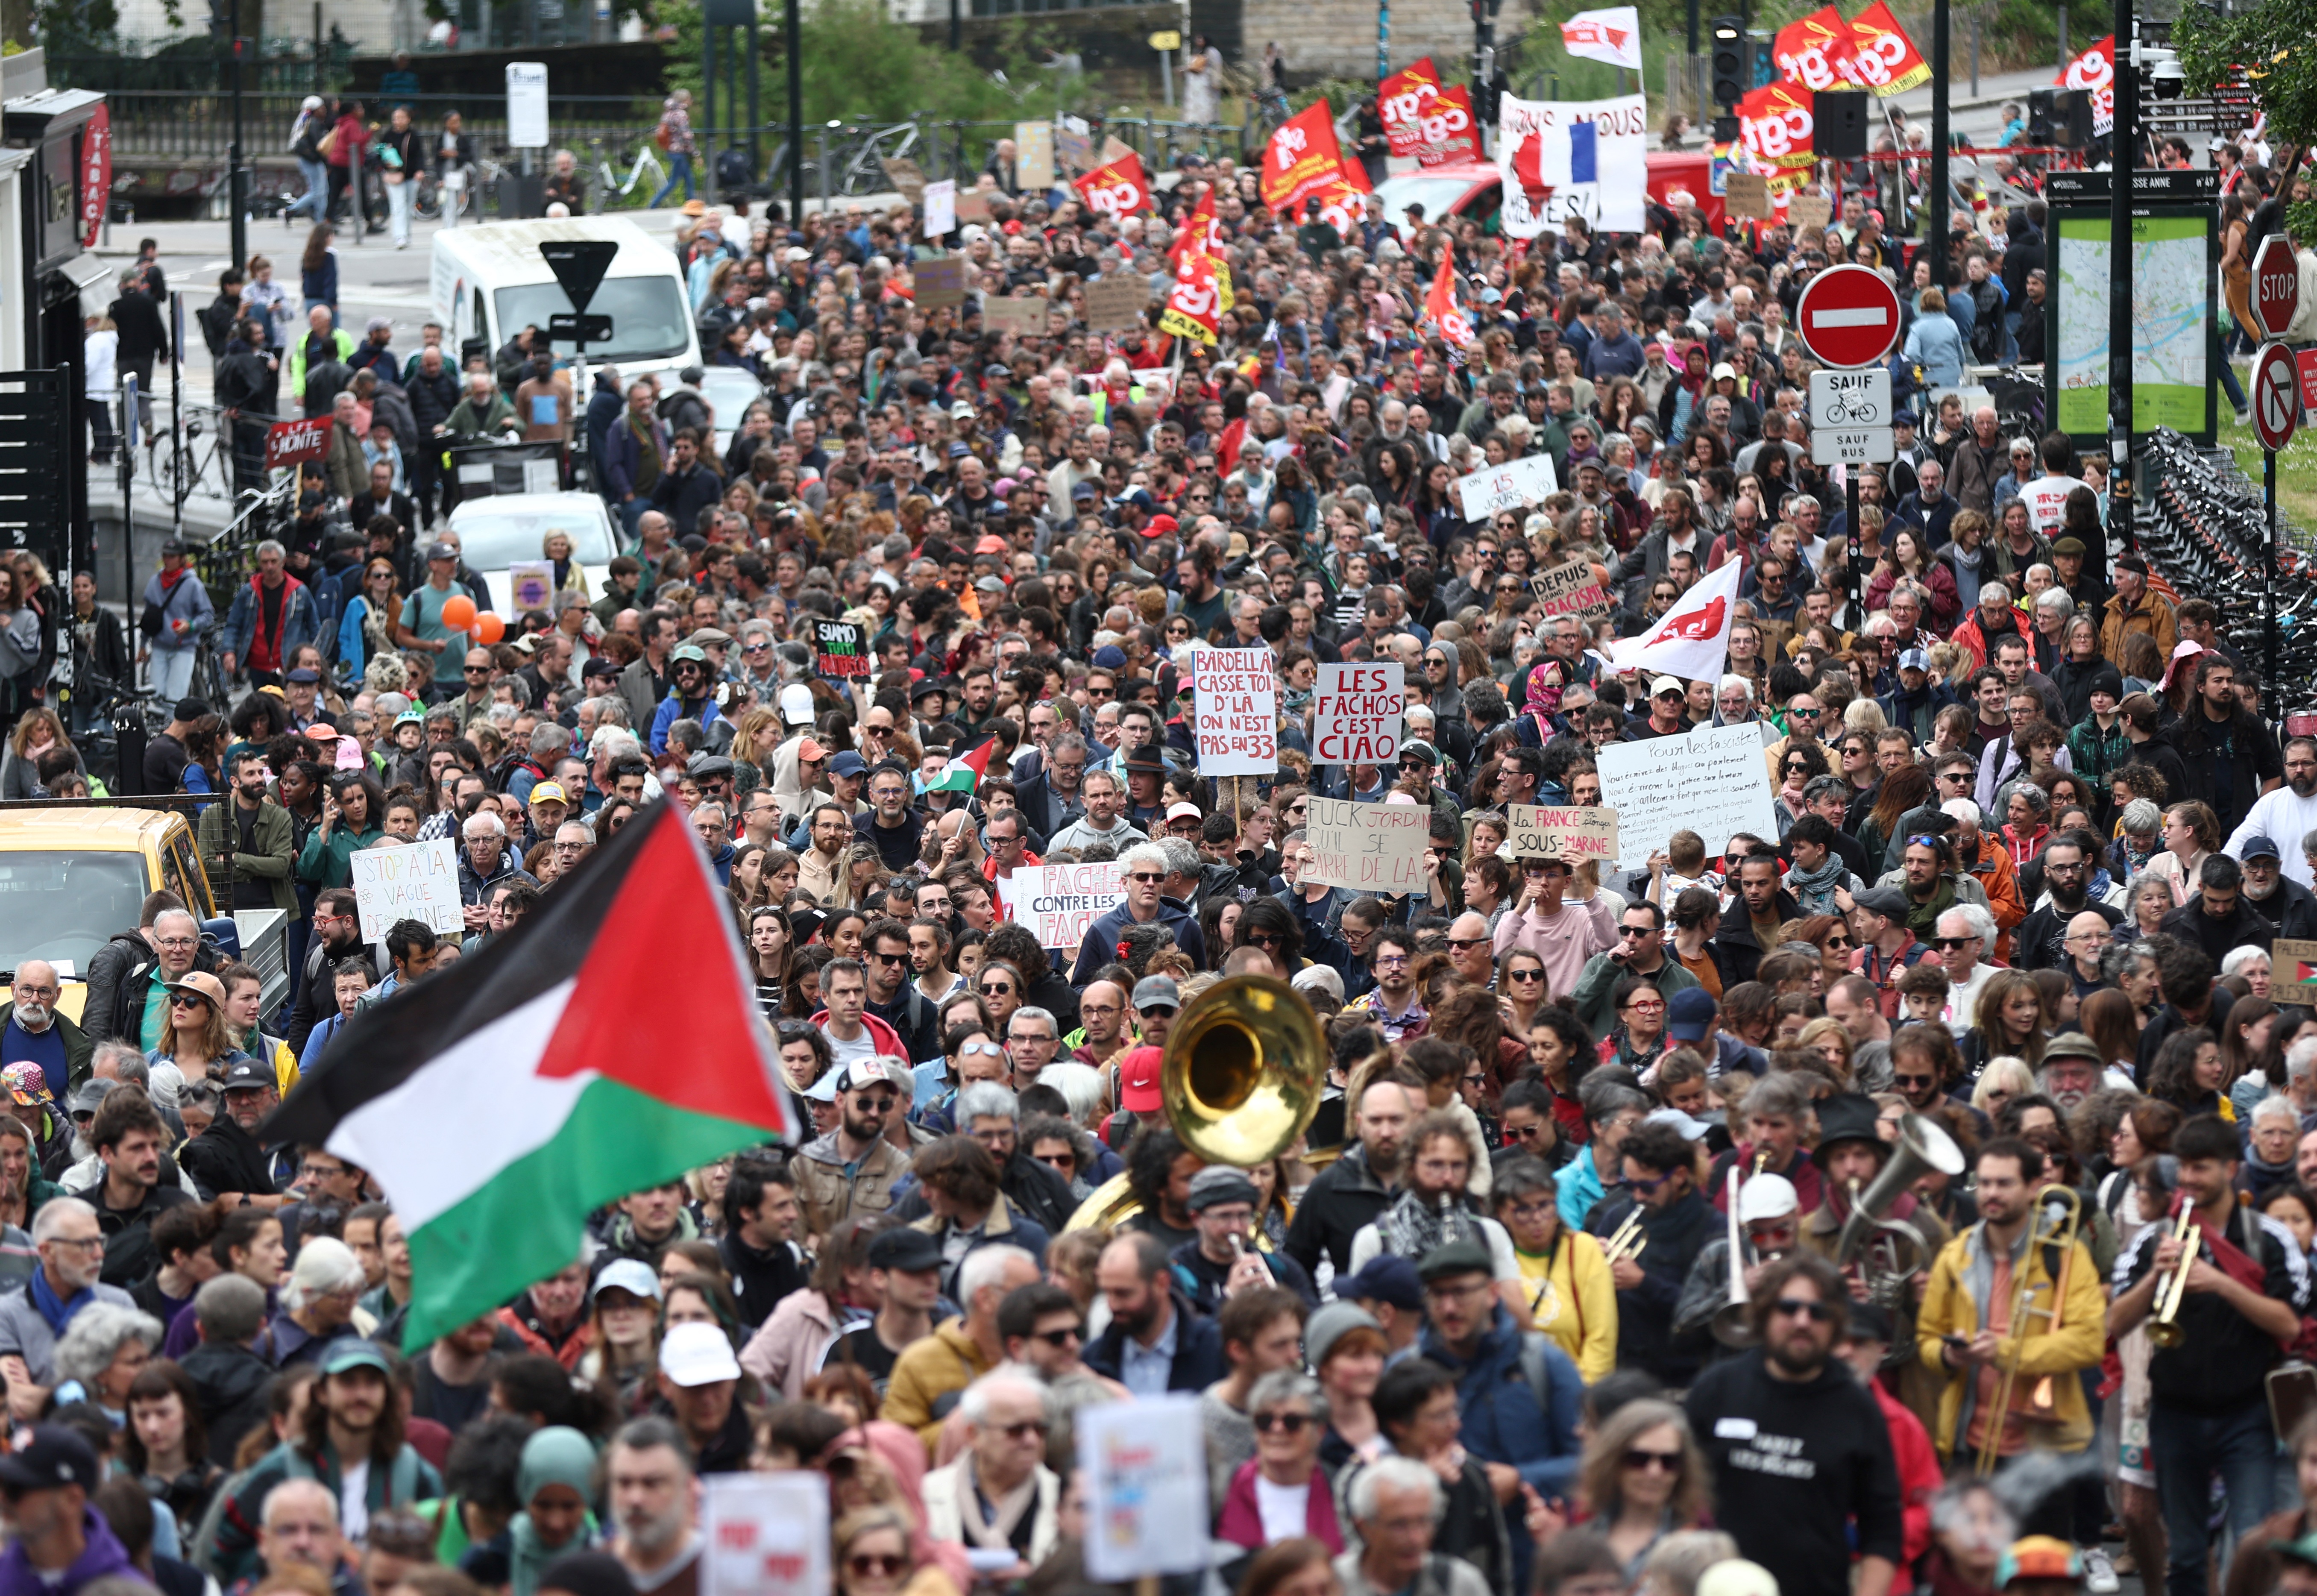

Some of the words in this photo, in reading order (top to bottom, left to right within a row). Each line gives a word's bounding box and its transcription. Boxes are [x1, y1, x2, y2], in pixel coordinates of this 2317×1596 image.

[2197, 106, 2216, 114] Jardin
[2229, 104, 2252, 113] Plantes
[2200, 123, 2215, 132] gare
[86, 132, 104, 219] TABAC
[2149, 177, 2170, 188] ANNE
[2262, 273, 2295, 301] STOP
[1830, 375, 1873, 390] SAUF
[1836, 434, 1869, 445] SAUF
[1841, 448, 1865, 458] BUS
[1469, 476, 1481, 487] ON
[1527, 461, 1535, 471] A
[1490, 472, 1514, 495] 15
[1484, 488, 1523, 510] JOURS
[1534, 562, 1589, 596] DEPUIS
[1541, 590, 1564, 603] QUAND
[1569, 582, 1580, 591] LE
[1544, 584, 1606, 616] RACISME
[818, 623, 857, 643] SIAMO
[825, 641, 856, 656] TUTTI
[1196, 651, 1273, 674] BARDELLA
[1198, 675, 1244, 692] CASSE
[1249, 674, 1271, 692] TOI
[1337, 669, 1387, 693] LES
[1318, 694, 1401, 716] FACHOS
[1200, 715, 1223, 730] ON
[1230, 714, 1271, 732] N'EST
[1333, 717, 1385, 735] C'EST
[1200, 735, 1229, 755] PAS
[1232, 736, 1247, 751] EN
[1248, 736, 1275, 760] 33
[1318, 735, 1394, 760] CIAO
[1647, 742, 1683, 757] Pour
[1687, 737, 1707, 755] les
[1707, 731, 1759, 751] fascistes
[1604, 772, 1624, 783] Vous
[1656, 765, 1668, 773] des
[1672, 761, 1693, 776] blagues
[1609, 787, 1624, 798] Nous
[1675, 777, 1701, 790] justice
[1676, 791, 1692, 801] fort
[1692, 790, 1701, 802] que
[1308, 798, 1363, 828] FUCK
[1367, 811, 1431, 830] JORDAN
[1514, 808, 1533, 828] La
[1536, 809, 1581, 828] FRANCE
[1582, 818, 1611, 830] plonger
[1308, 826, 1345, 852] QU'IL
[1362, 833, 1390, 854] SE
[1620, 839, 1636, 849] Vous
[1639, 833, 1666, 845] écrivez
[1699, 821, 1713, 830] sur
[1716, 814, 1722, 826] la
[1725, 814, 1746, 825] terre
[364, 854, 403, 882] STOP
[410, 850, 422, 878] À
[427, 850, 447, 876] LA
[1624, 851, 1642, 861] Nous
[1304, 853, 1351, 881] BARRE
[1361, 857, 1384, 883] DE
[384, 883, 433, 906] VAGUE
[1032, 895, 1089, 912] CONTRE
[1094, 895, 1116, 909] LES
[367, 913, 385, 938] DE
